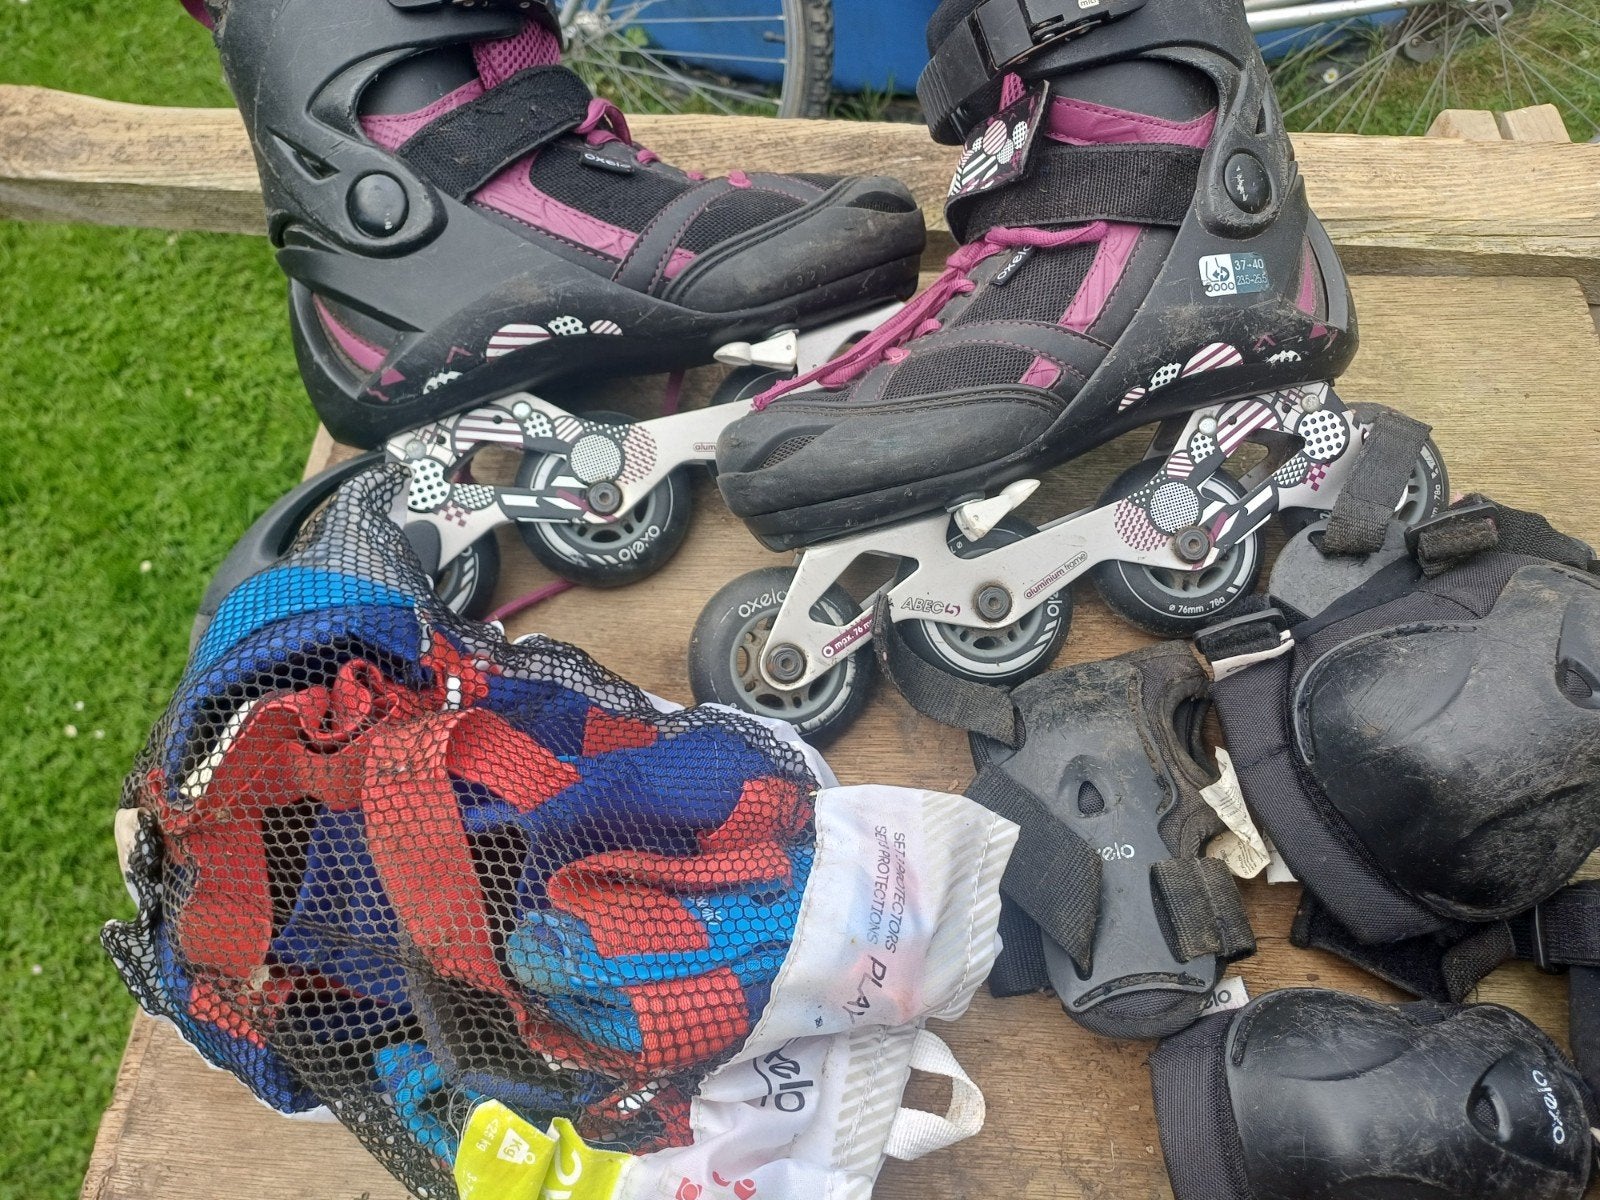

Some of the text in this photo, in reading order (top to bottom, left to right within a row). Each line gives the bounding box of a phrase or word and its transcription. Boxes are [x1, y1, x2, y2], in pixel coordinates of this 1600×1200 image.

[1234, 258, 1265, 271] 37-40
[618, 524, 661, 562] oxelo
[1025, 568, 1066, 599] aluminium
[1177, 604, 1205, 614] 76mm
[834, 634, 856, 650] max.
[852, 625, 864, 636] 76
[866, 849, 891, 945] PROTECTIONS
